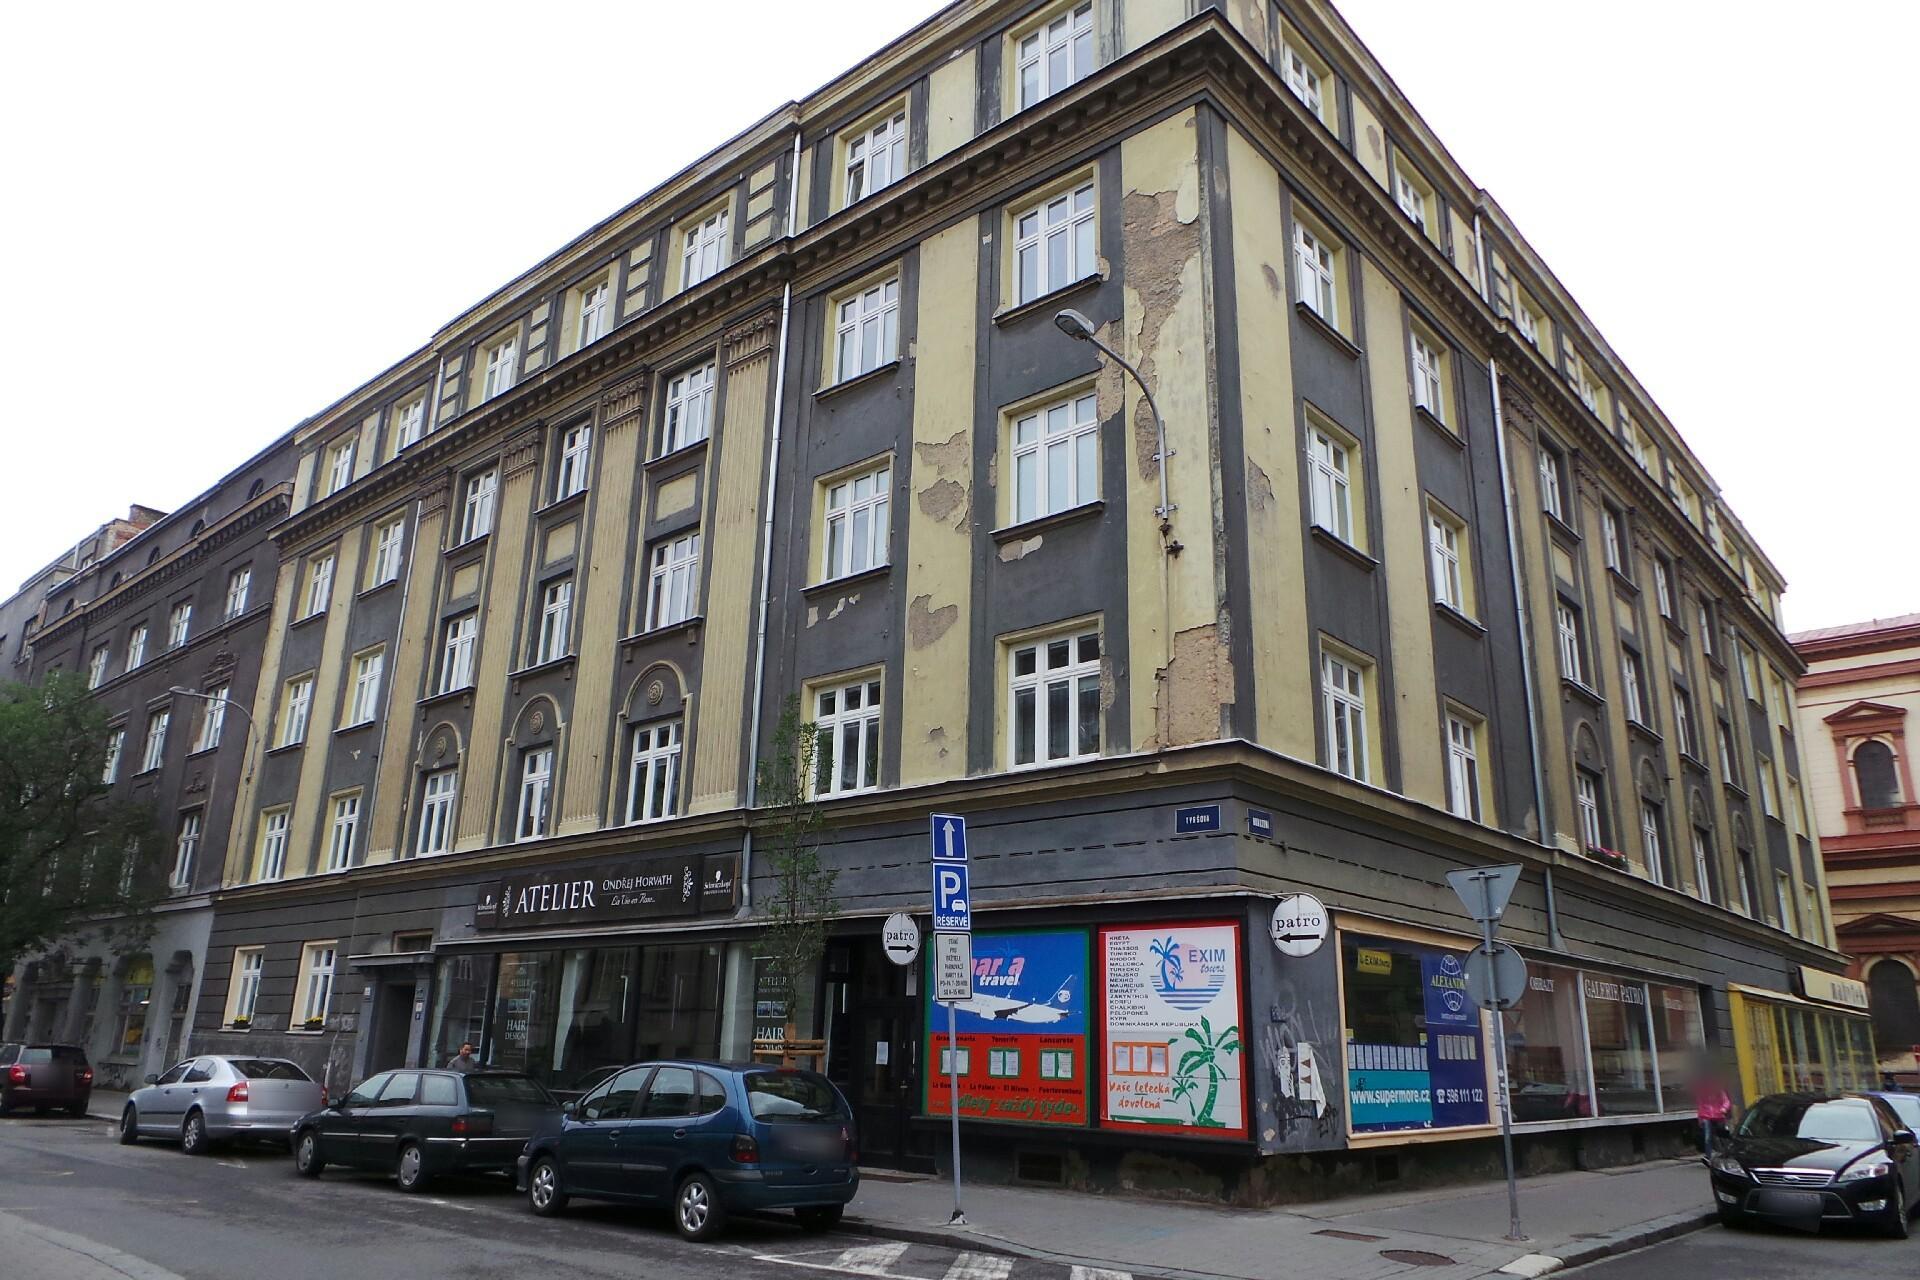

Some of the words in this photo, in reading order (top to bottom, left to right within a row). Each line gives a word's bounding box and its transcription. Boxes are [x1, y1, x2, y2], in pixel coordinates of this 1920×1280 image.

[603, 877, 633, 894] ONDŘEJ
[635, 874, 673, 888] HORVATH
[940, 871, 961, 909] P
[515, 880, 596, 914] ATELIER
[937, 913, 968, 927] RÉSERVÉ
[1275, 915, 1320, 932] patro
[886, 931, 915, 943] patro
[1189, 949, 1225, 963] EXIM
[1200, 964, 1225, 974] tours
[979, 974, 1020, 986] travel
[1584, 979, 1620, 1001] GALERIE
[1620, 984, 1644, 1006] PATRO
[506, 1020, 527, 1031] HAIR
[505, 1031, 527, 1040] DESIGN
[756, 1027, 785, 1040] HAIR
[1109, 1080, 1131, 1092] Vaše
[1134, 1081, 1170, 1094] letecká
[1118, 1095, 1161, 1109] dovolená
[1350, 1088, 1431, 1108] www.supermore.cz
[1446, 1088, 1459, 1104] 596
[1459, 1089, 1470, 1103] 111
[1471, 1088, 1484, 1103] 122
